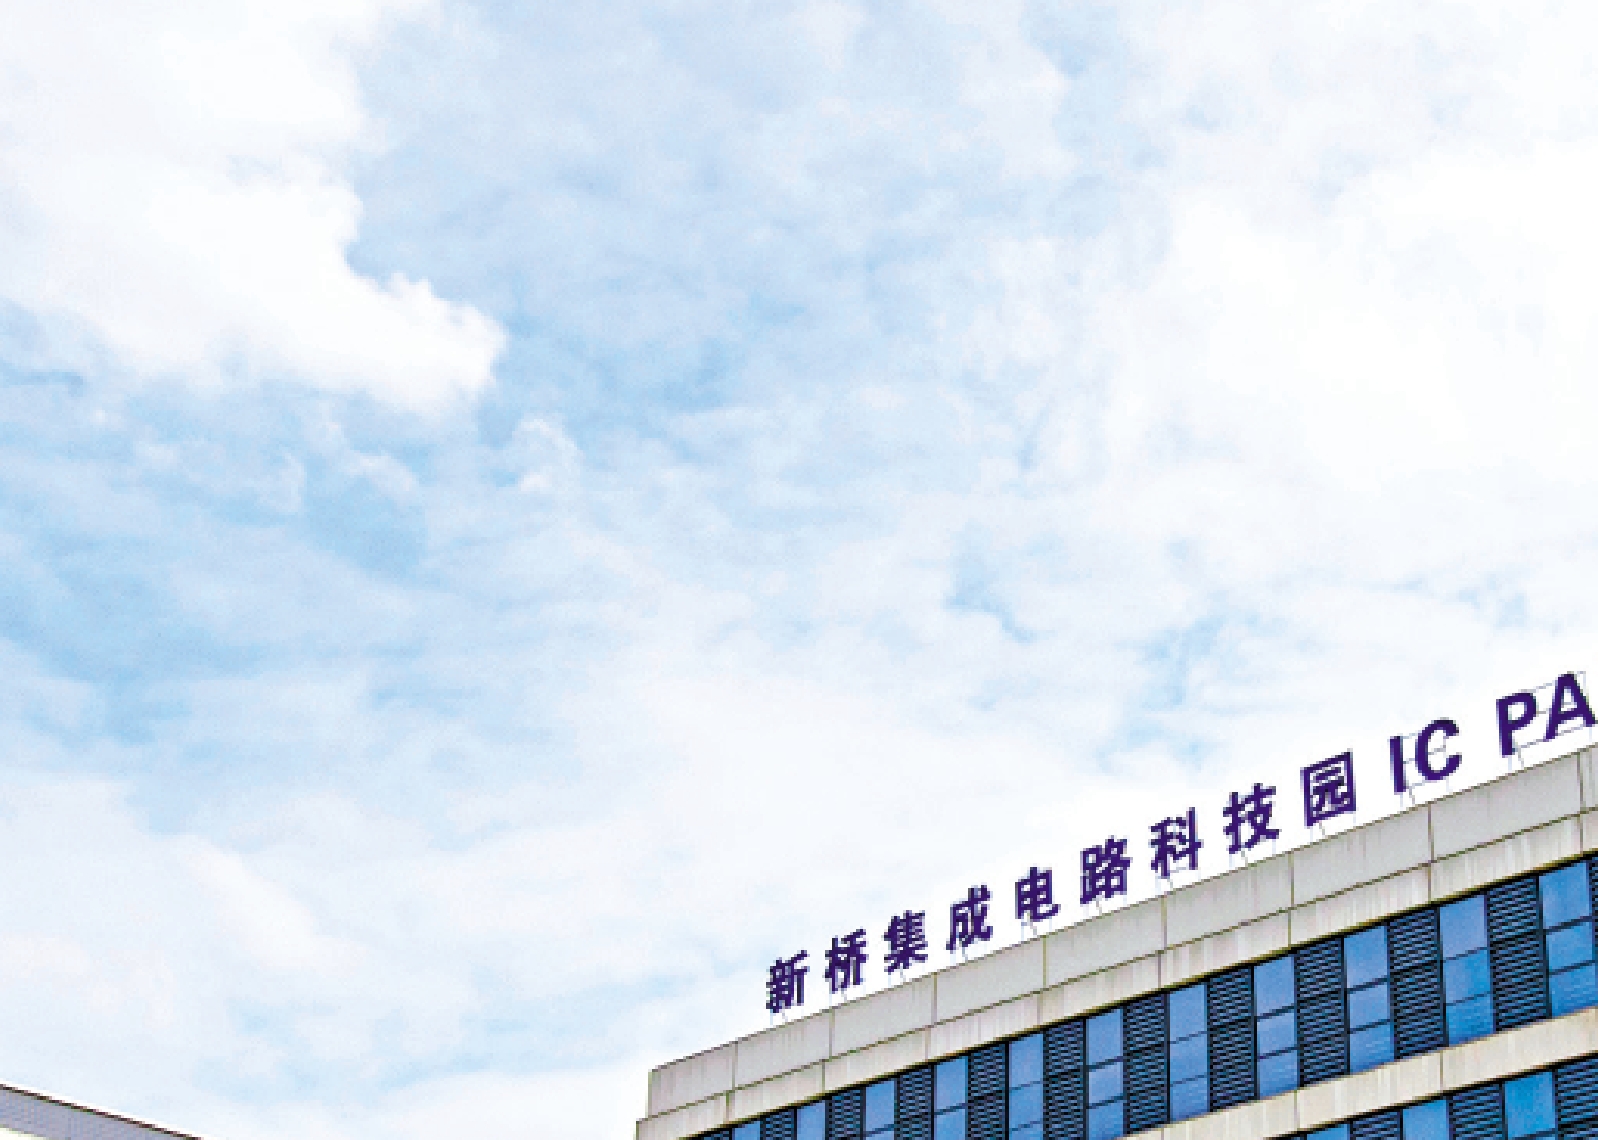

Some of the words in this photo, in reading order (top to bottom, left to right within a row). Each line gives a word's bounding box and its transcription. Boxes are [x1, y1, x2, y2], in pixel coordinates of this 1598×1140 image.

[1389, 719, 1462, 793] IC
[765, 751, 1358, 1014] 新桥集成电路科技园
